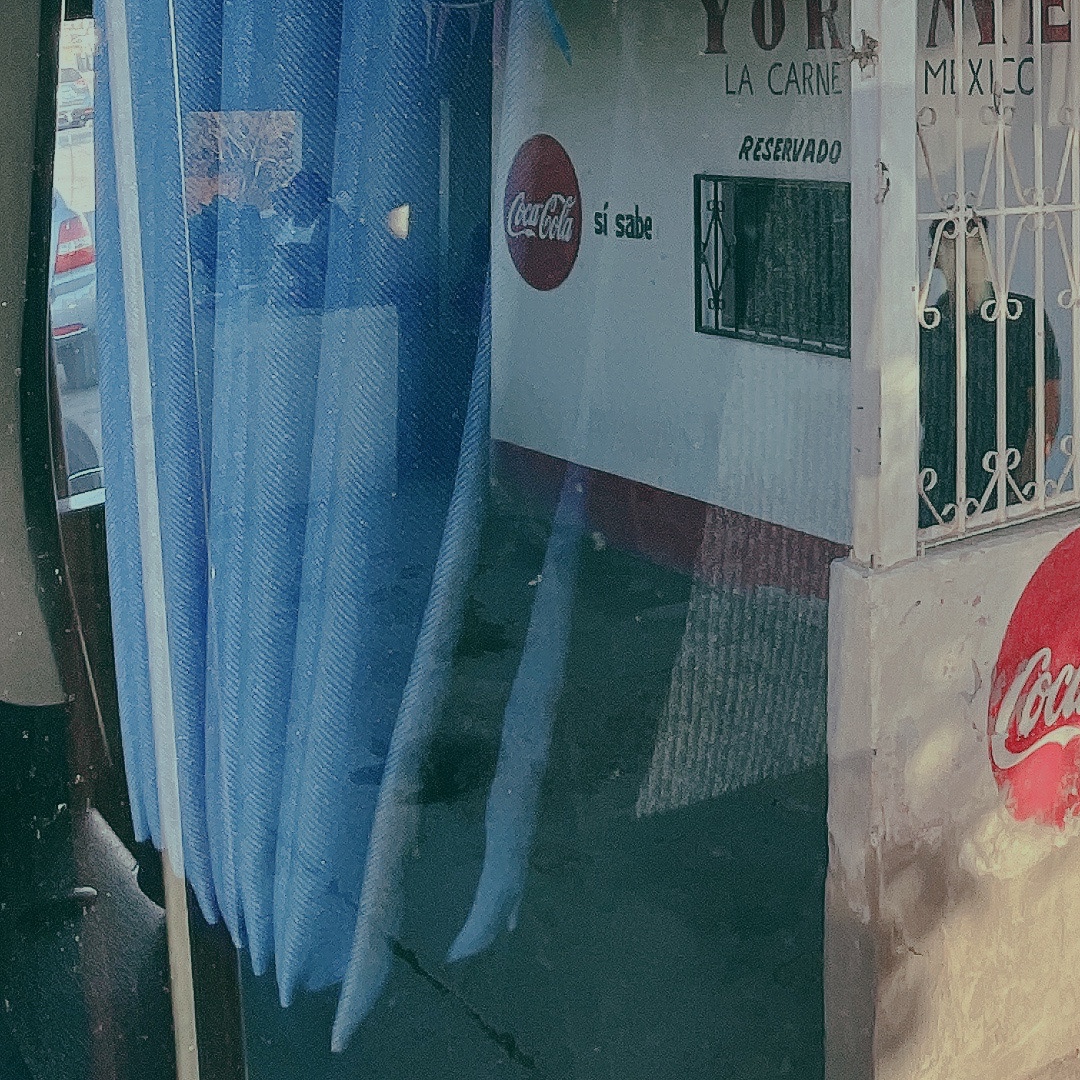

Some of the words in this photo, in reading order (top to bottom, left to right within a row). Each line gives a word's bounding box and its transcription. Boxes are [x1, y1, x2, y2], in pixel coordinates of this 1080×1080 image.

[724, 63, 754, 95] LA
[767, 61, 843, 95] CARNE
[738, 135, 842, 164] RESERVADO
[615, 204, 653, 240] sabe
